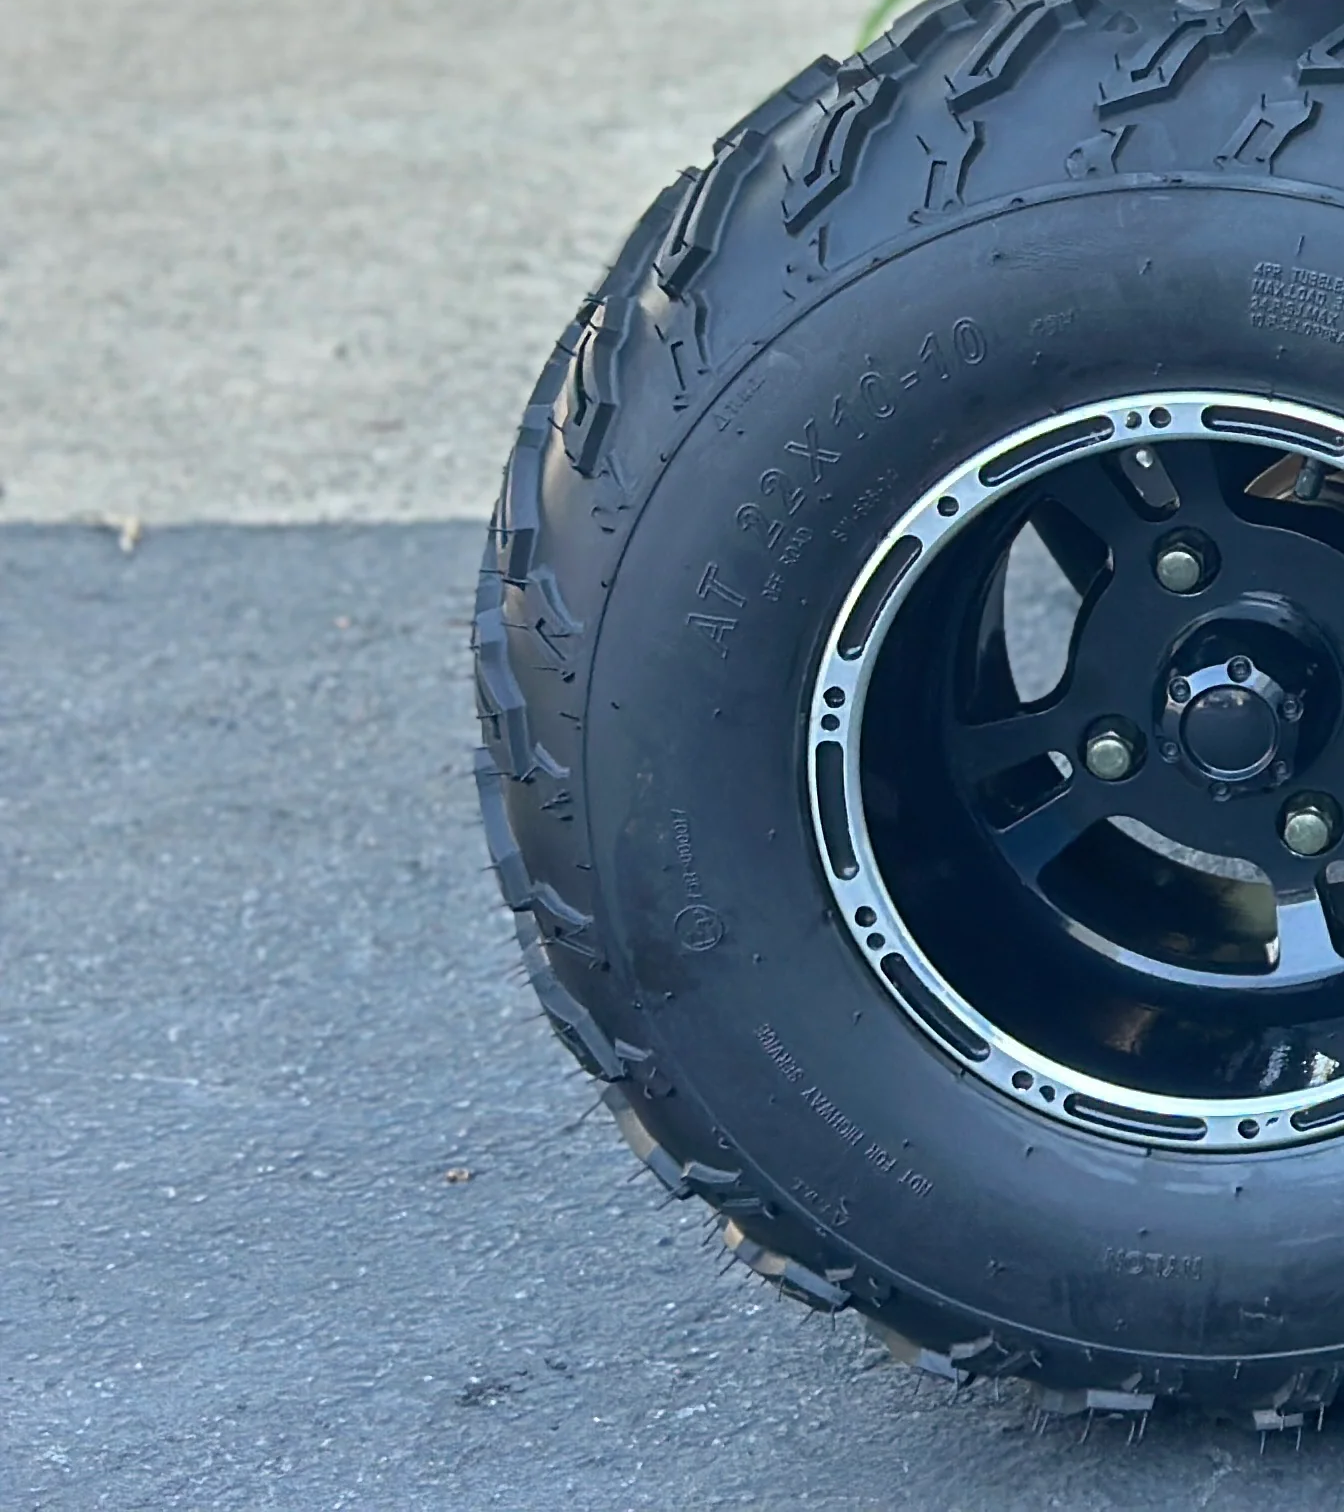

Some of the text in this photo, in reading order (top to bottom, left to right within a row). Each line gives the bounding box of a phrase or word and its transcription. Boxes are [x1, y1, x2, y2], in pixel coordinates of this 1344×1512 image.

[686, 561, 748, 659] AT
[734, 317, 988, 549] 22X10-10
[801, 1085, 866, 1147] HIGHWAY
[864, 1141, 898, 1173] FOR
[898, 1168, 935, 1198] NOT
